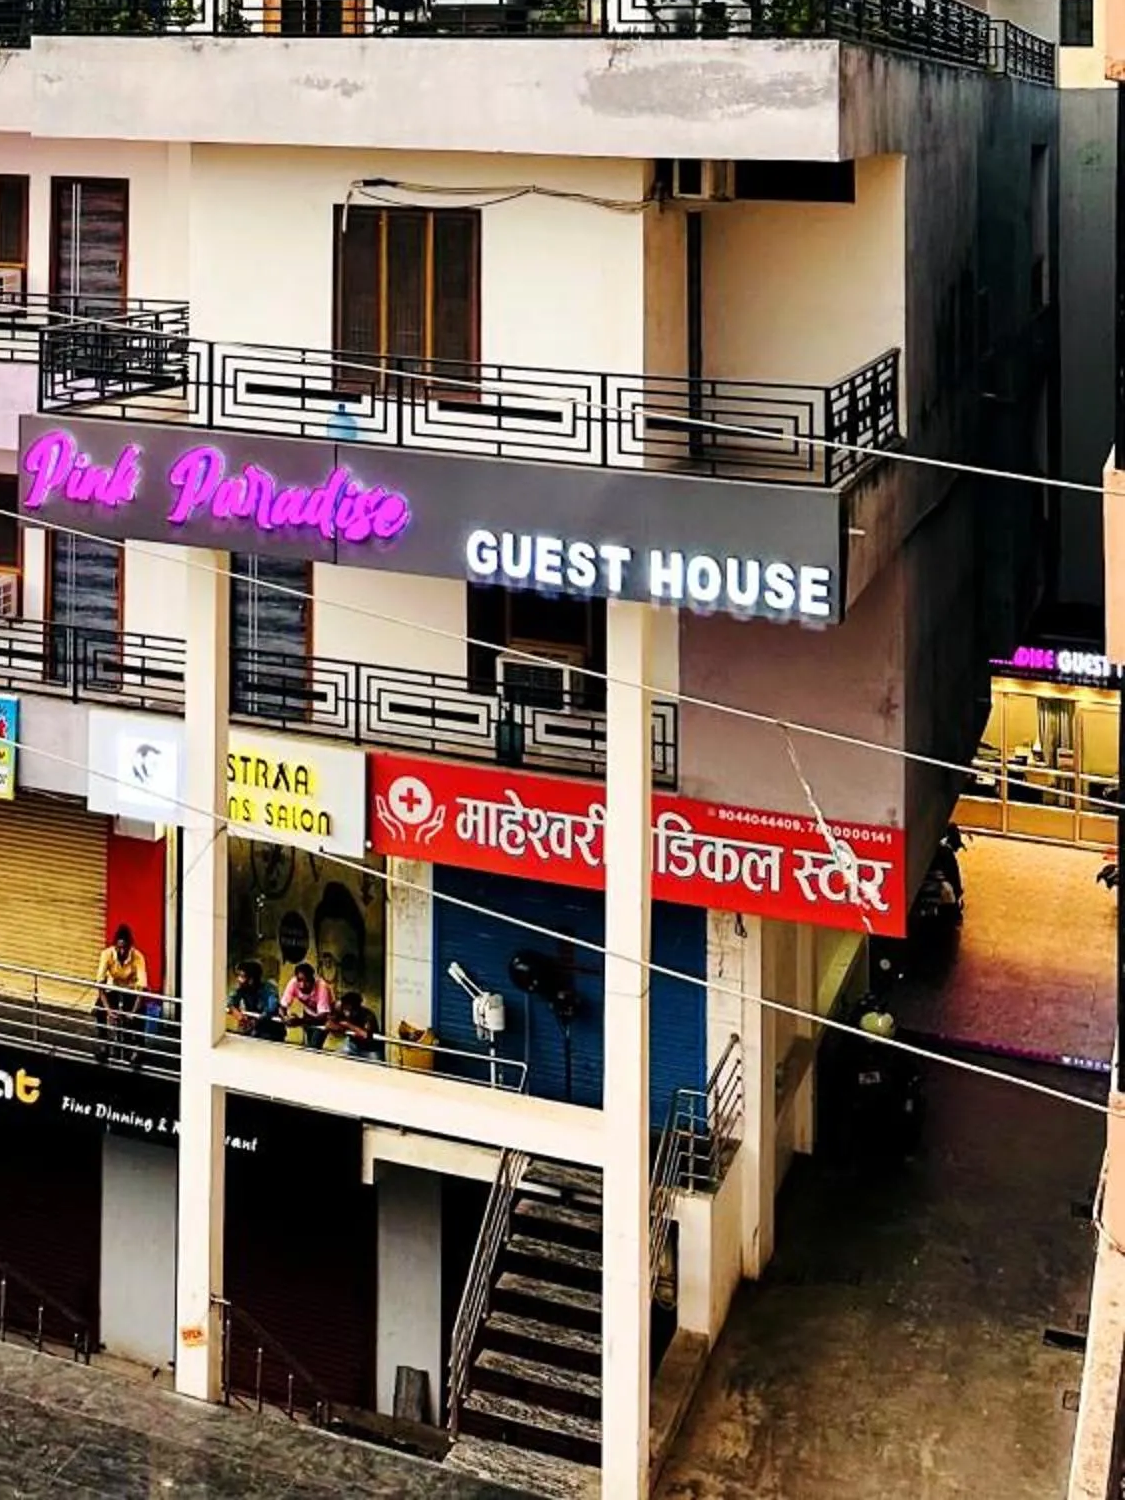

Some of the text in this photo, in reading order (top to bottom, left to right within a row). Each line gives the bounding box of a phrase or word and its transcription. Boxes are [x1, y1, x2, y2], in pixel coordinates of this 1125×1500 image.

[22, 431, 410, 543] Pink Paradise
[466, 529, 831, 616] GUEST HOUSE
[226, 753, 310, 796] STRAA
[792, 840, 893, 911] स्टोर
[61, 1096, 92, 1115] Fine
[94, 1103, 154, 1133] Dinning
[156, 1117, 168, 1132] &
